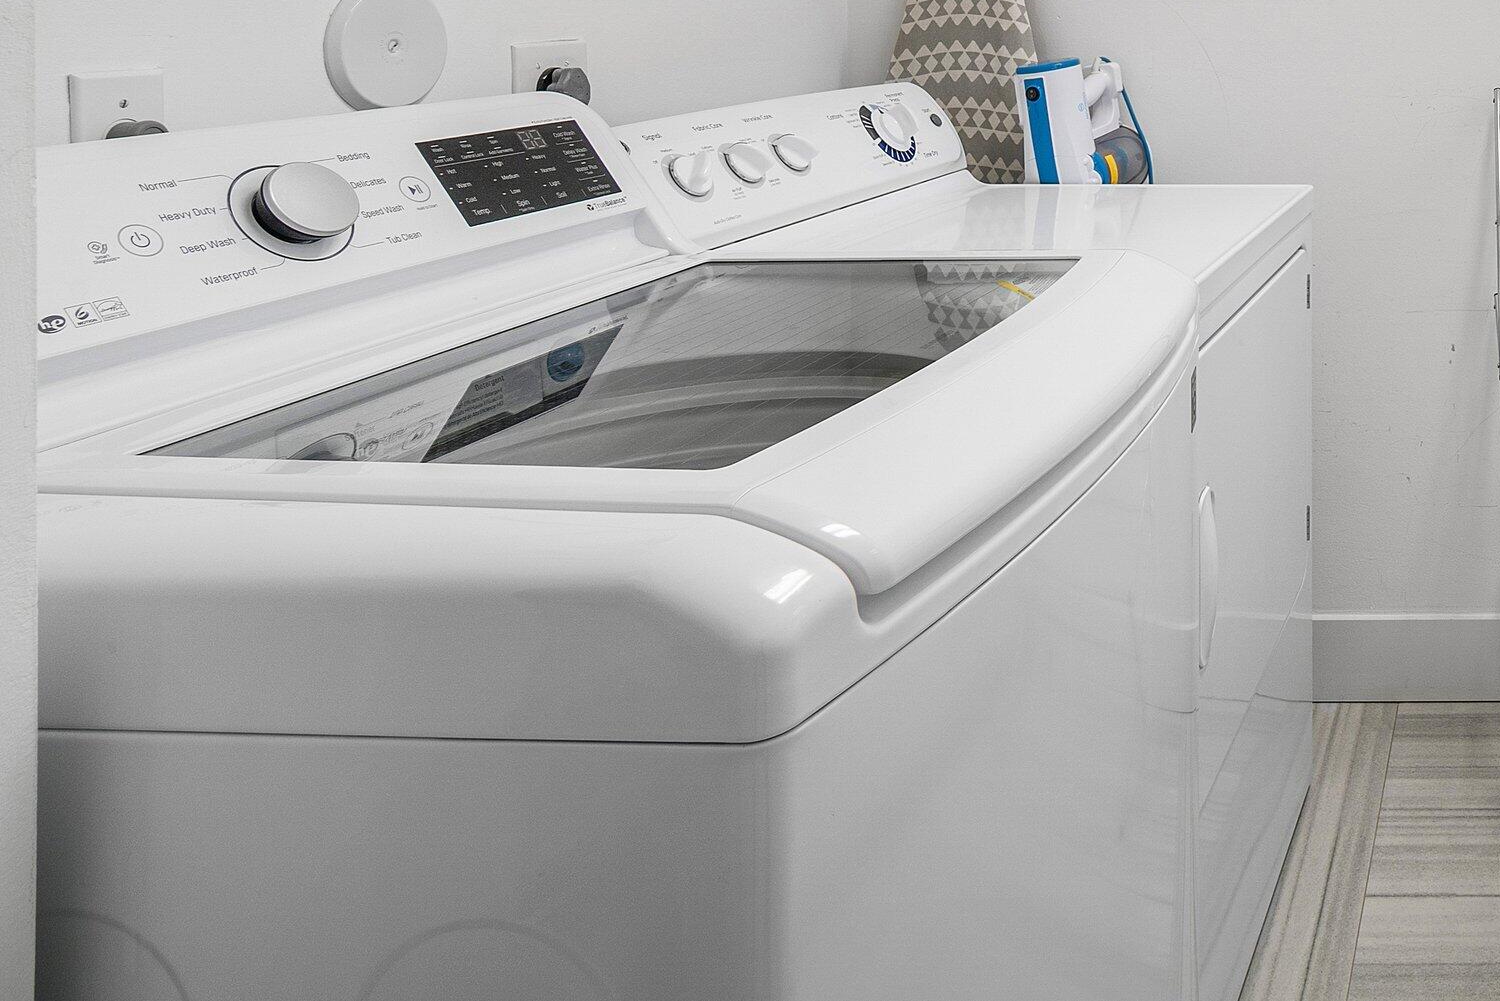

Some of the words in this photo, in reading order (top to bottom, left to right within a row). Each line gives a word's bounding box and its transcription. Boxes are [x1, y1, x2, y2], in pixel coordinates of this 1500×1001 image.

[336, 151, 371, 163] Bedding
[139, 179, 178, 192] Normal
[350, 177, 387, 190] Delicates
[455, 181, 473, 189] Warm
[516, 199, 531, 208] Spin
[158, 211, 192, 222] Heavy
[191, 207, 217, 217] Duty
[361, 207, 386, 219] Speed
[384, 203, 405, 214] Wash
[472, 207, 492, 216] Temp.
[386, 233, 402, 245] Tub
[401, 230, 422, 243] Clean
[179, 243, 207, 255] Deep
[206, 237, 237, 250] Wash
[200, 266, 258, 287] Waterproof
[474, 375, 505, 391] Detergent
